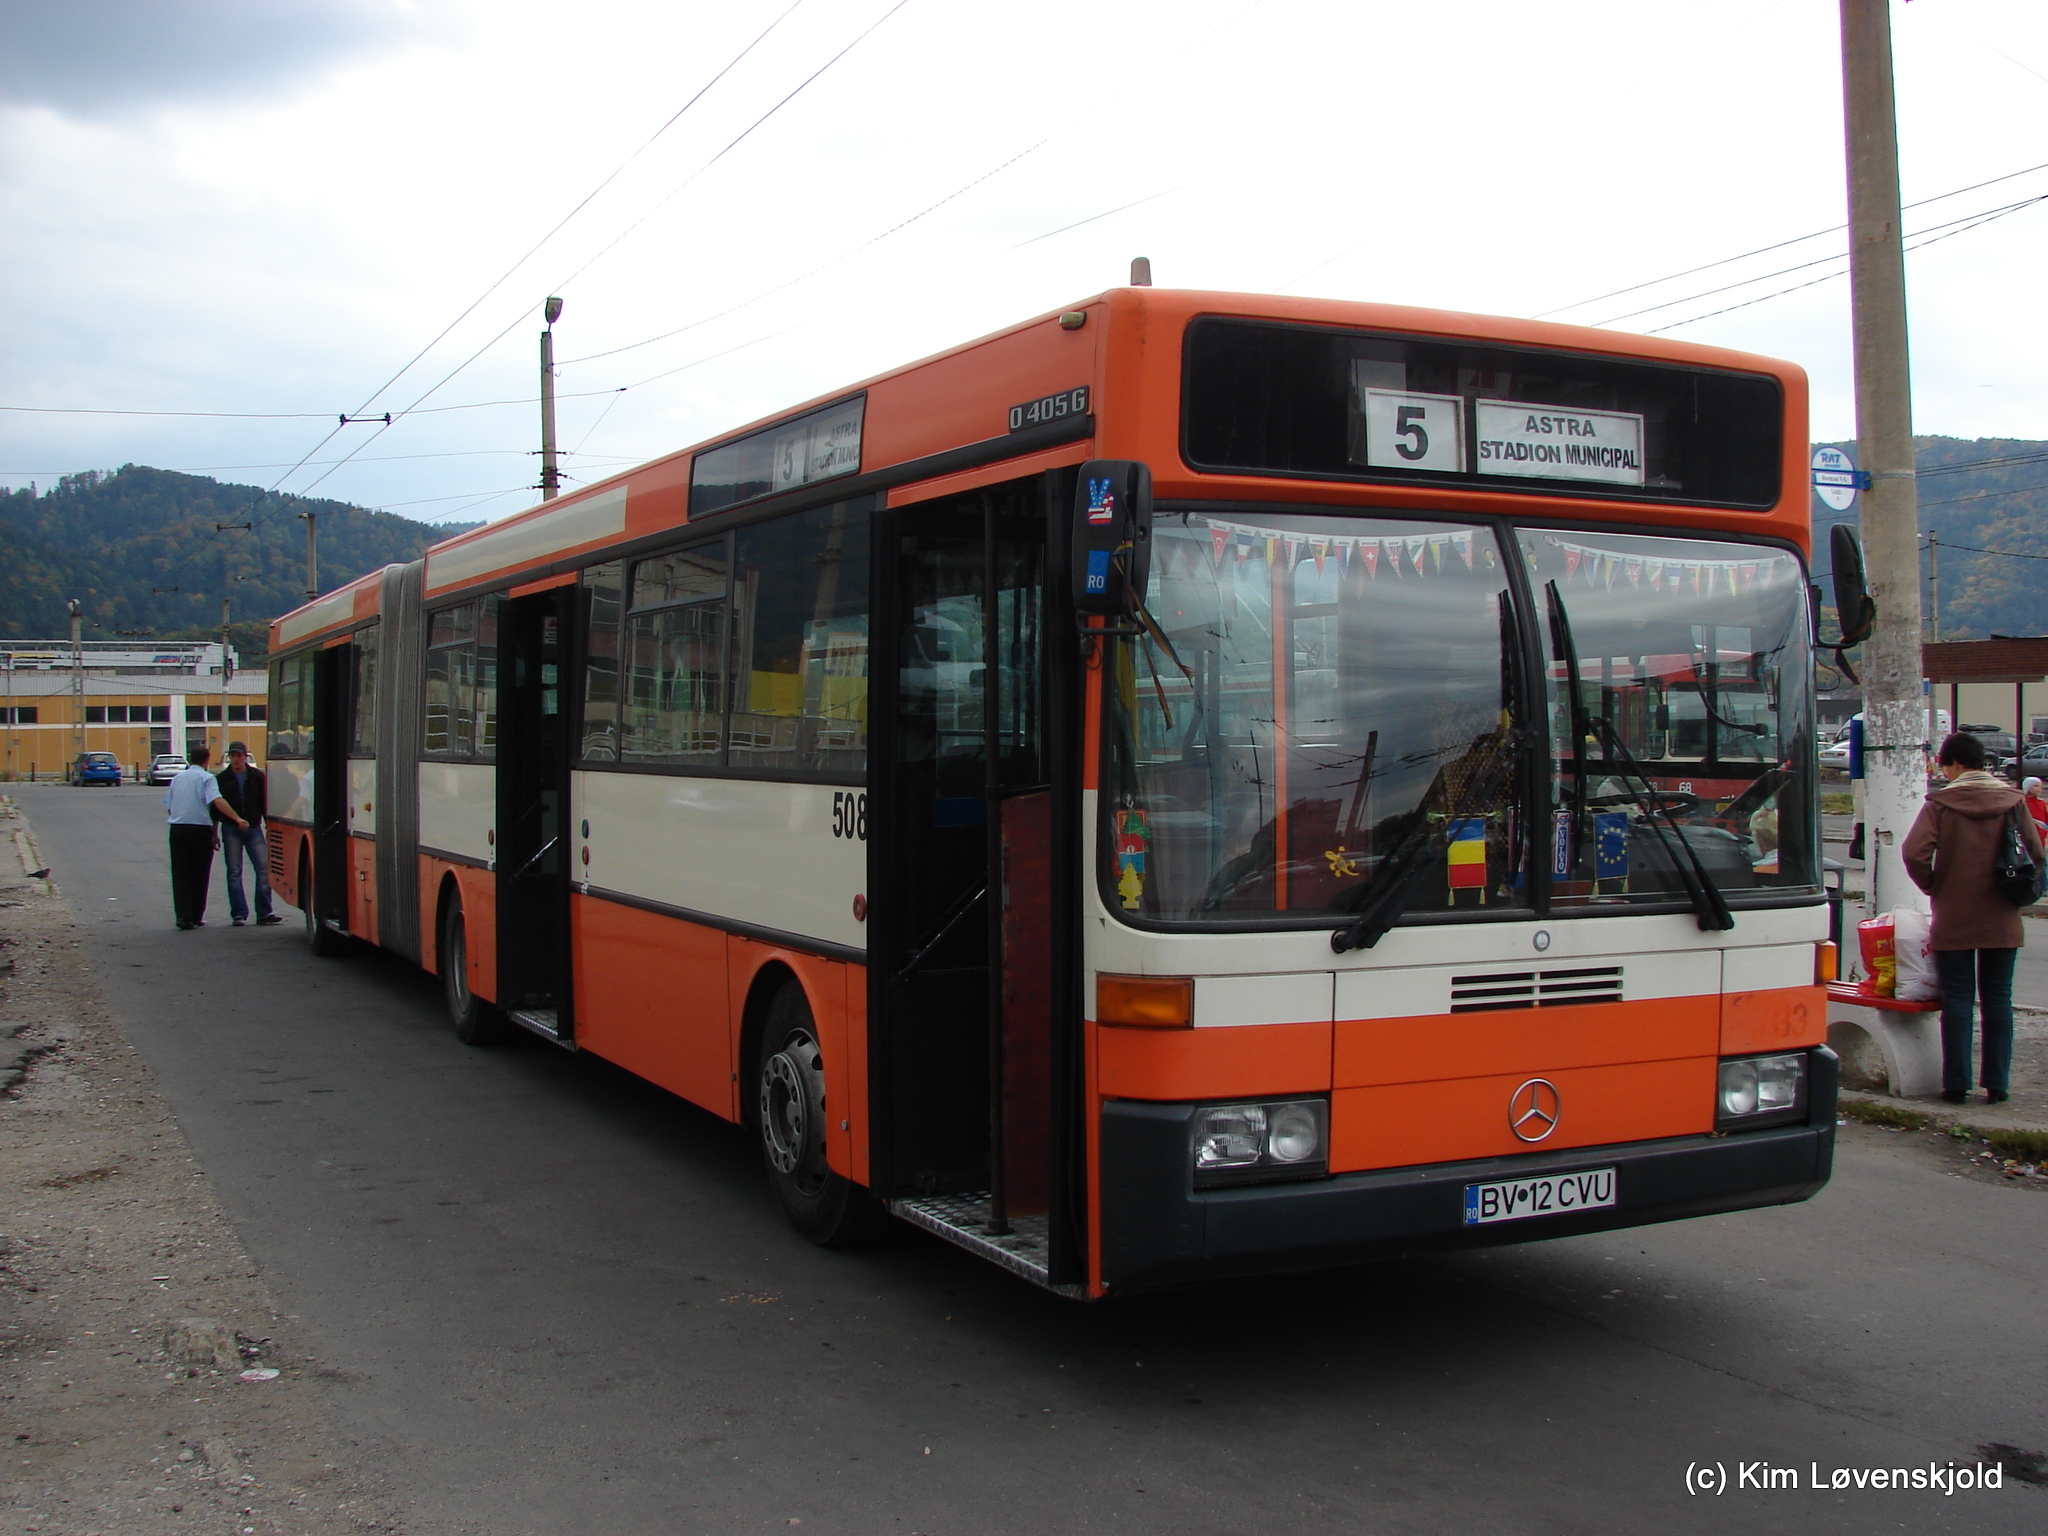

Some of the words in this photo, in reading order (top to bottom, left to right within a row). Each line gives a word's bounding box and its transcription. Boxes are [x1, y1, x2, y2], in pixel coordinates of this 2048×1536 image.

[1027, 394, 1067, 422] 405
[1072, 389, 1085, 412] G
[831, 421, 857, 439] ASTRA
[1395, 406, 1429, 461] 5
[1525, 416, 1596, 438] ASTRA
[783, 440, 794, 481] 5
[1480, 441, 1561, 464] STADION
[1566, 443, 1639, 469] MUNICIPAL
[1820, 453, 1841, 464] RAT
[1088, 575, 1105, 589] RO
[1679, 782, 1691, 793] 68
[833, 791, 867, 841] 508
[1558, 829, 1566, 870] VOLVO
[1558, 1173, 1612, 1206] CVU
[1466, 1208, 1478, 1220] RO
